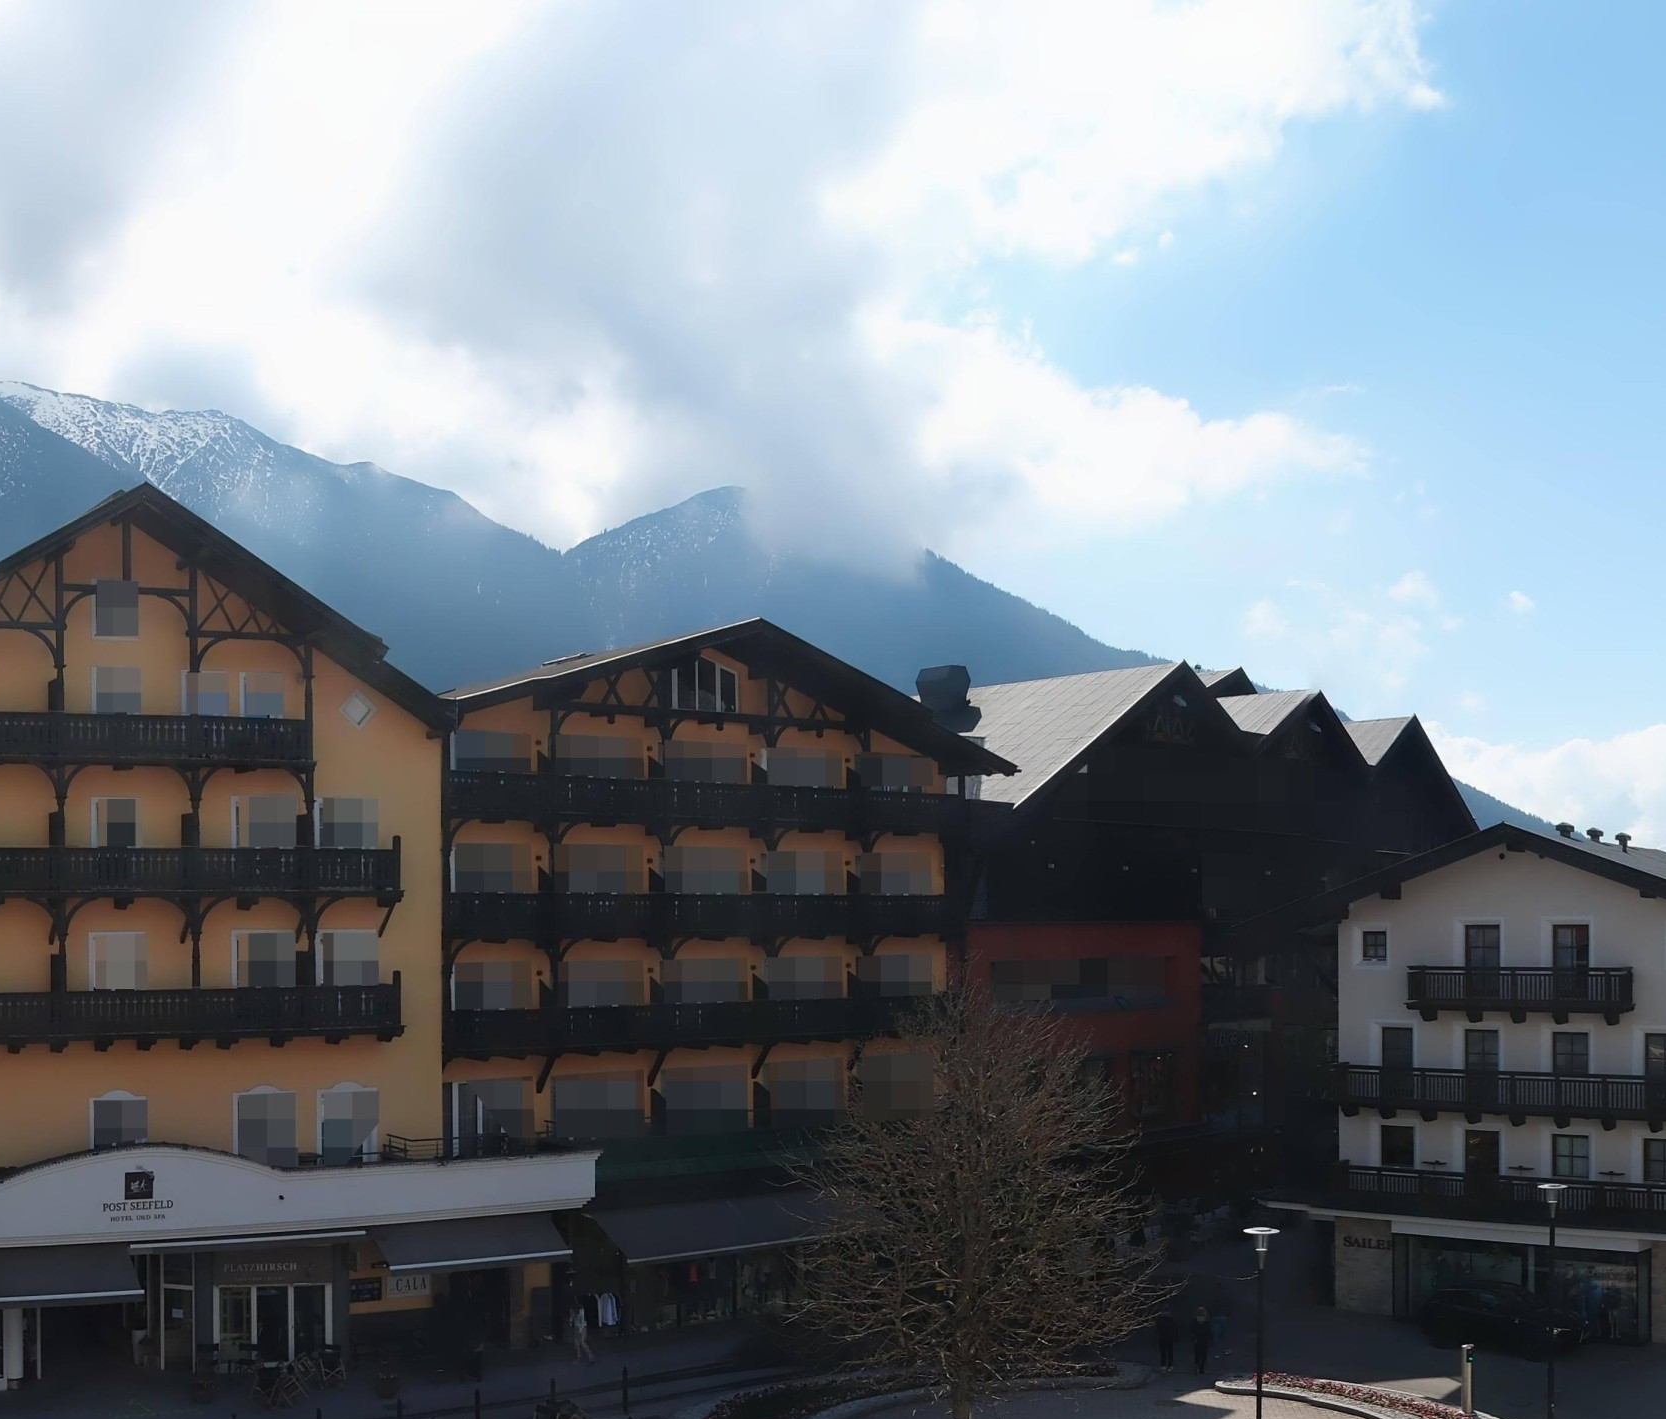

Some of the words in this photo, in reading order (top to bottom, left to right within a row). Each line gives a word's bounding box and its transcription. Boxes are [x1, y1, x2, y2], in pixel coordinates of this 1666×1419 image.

[102, 1202, 128, 1212] POST
[130, 1200, 174, 1211] SEEFELD
[223, 1261, 298, 1273] PLATZHIRSCH
